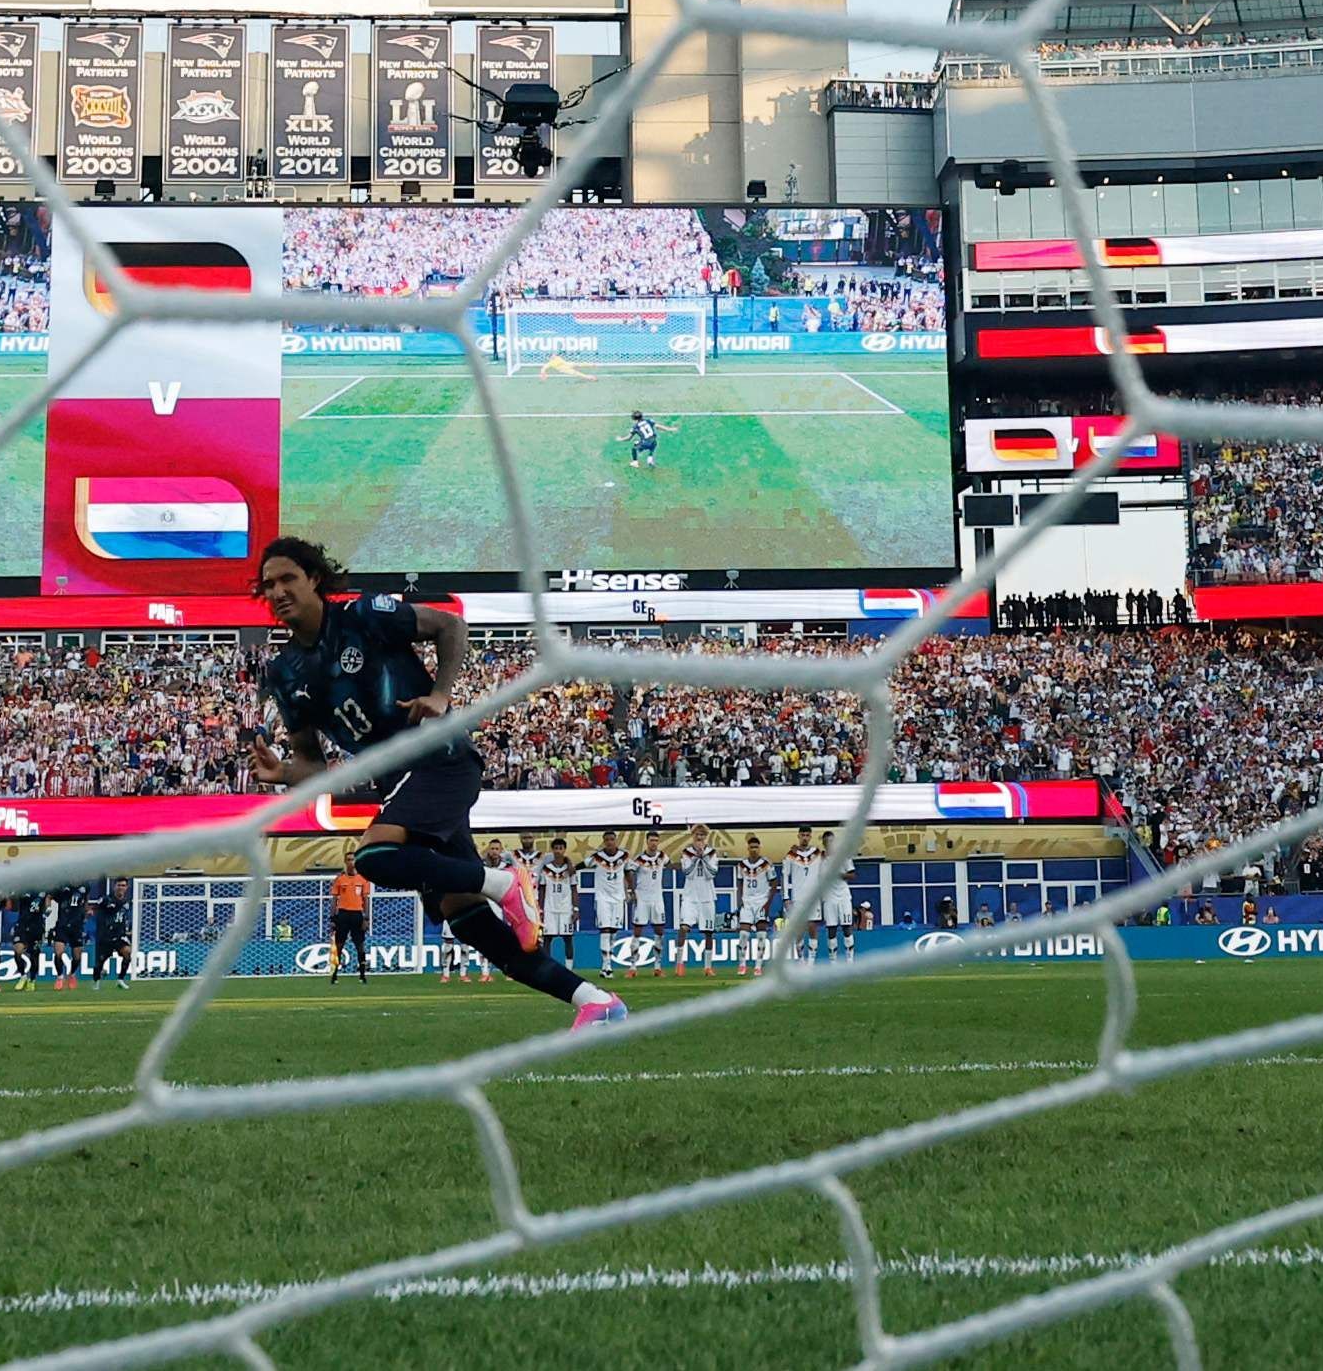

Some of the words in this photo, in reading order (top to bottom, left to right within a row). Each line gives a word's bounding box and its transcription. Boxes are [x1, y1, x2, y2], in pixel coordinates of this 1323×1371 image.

[68, 58, 90, 67] NEW
[93, 58, 136, 67] ENGLAND
[173, 59, 195, 67] NEW
[197, 59, 240, 68] ENGLAND
[277, 59, 298, 68] NEW
[301, 59, 344, 68] ENGLAND
[379, 60, 401, 69] NEW
[403, 60, 446, 69] ENGLAND
[482, 61, 503, 69] NEW
[506, 61, 548, 69] ENGLAND
[76, 67, 128, 77] PATRIOTS
[180, 68, 232, 78] PATRIOTS
[284, 69, 336, 78] PATRIOTS
[387, 70, 439, 79] PATRIOTS
[489, 70, 540, 79] PATRIOTS
[285, 119, 334, 132] XLIX
[78, 134, 121, 145] WORLD
[183, 134, 226, 145] WORLD
[287, 135, 330, 146] WORLD
[391, 136, 434, 146] WORLD
[65, 145, 134, 157] CHAMPIONS
[171, 146, 239, 157] CHAMPIONS
[275, 146, 343, 157] CHAMPIONS
[379, 147, 446, 157] CHAMPIONS
[65, 157, 132, 175] 2003
[171, 158, 238, 175] 2004
[279, 158, 339, 175] 2014
[384, 159, 441, 175] 2016
[312, 336, 401, 351] HYUNDAI
[561, 569, 680, 591] Hisense
[333, 697, 373, 742] 13
